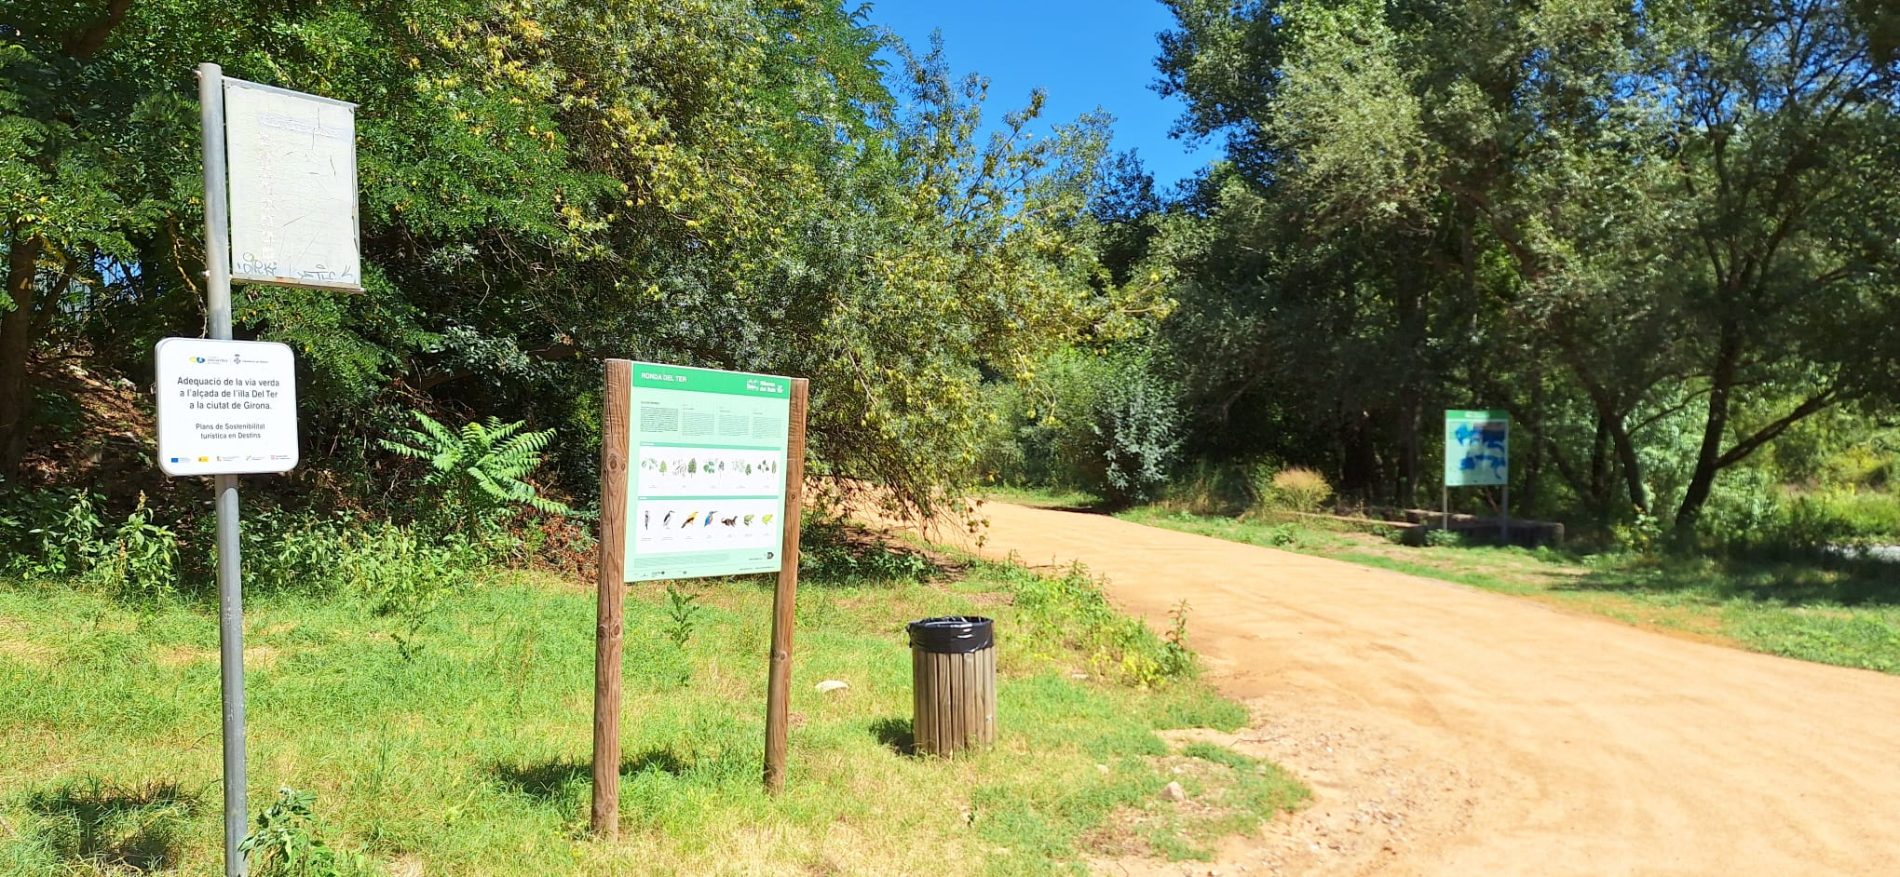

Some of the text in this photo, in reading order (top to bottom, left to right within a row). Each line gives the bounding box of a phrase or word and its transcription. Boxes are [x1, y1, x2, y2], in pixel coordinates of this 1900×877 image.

[178, 376, 222, 386] Adequació
[187, 389, 219, 399] l'alçada
[244, 402, 272, 410] Girona.
